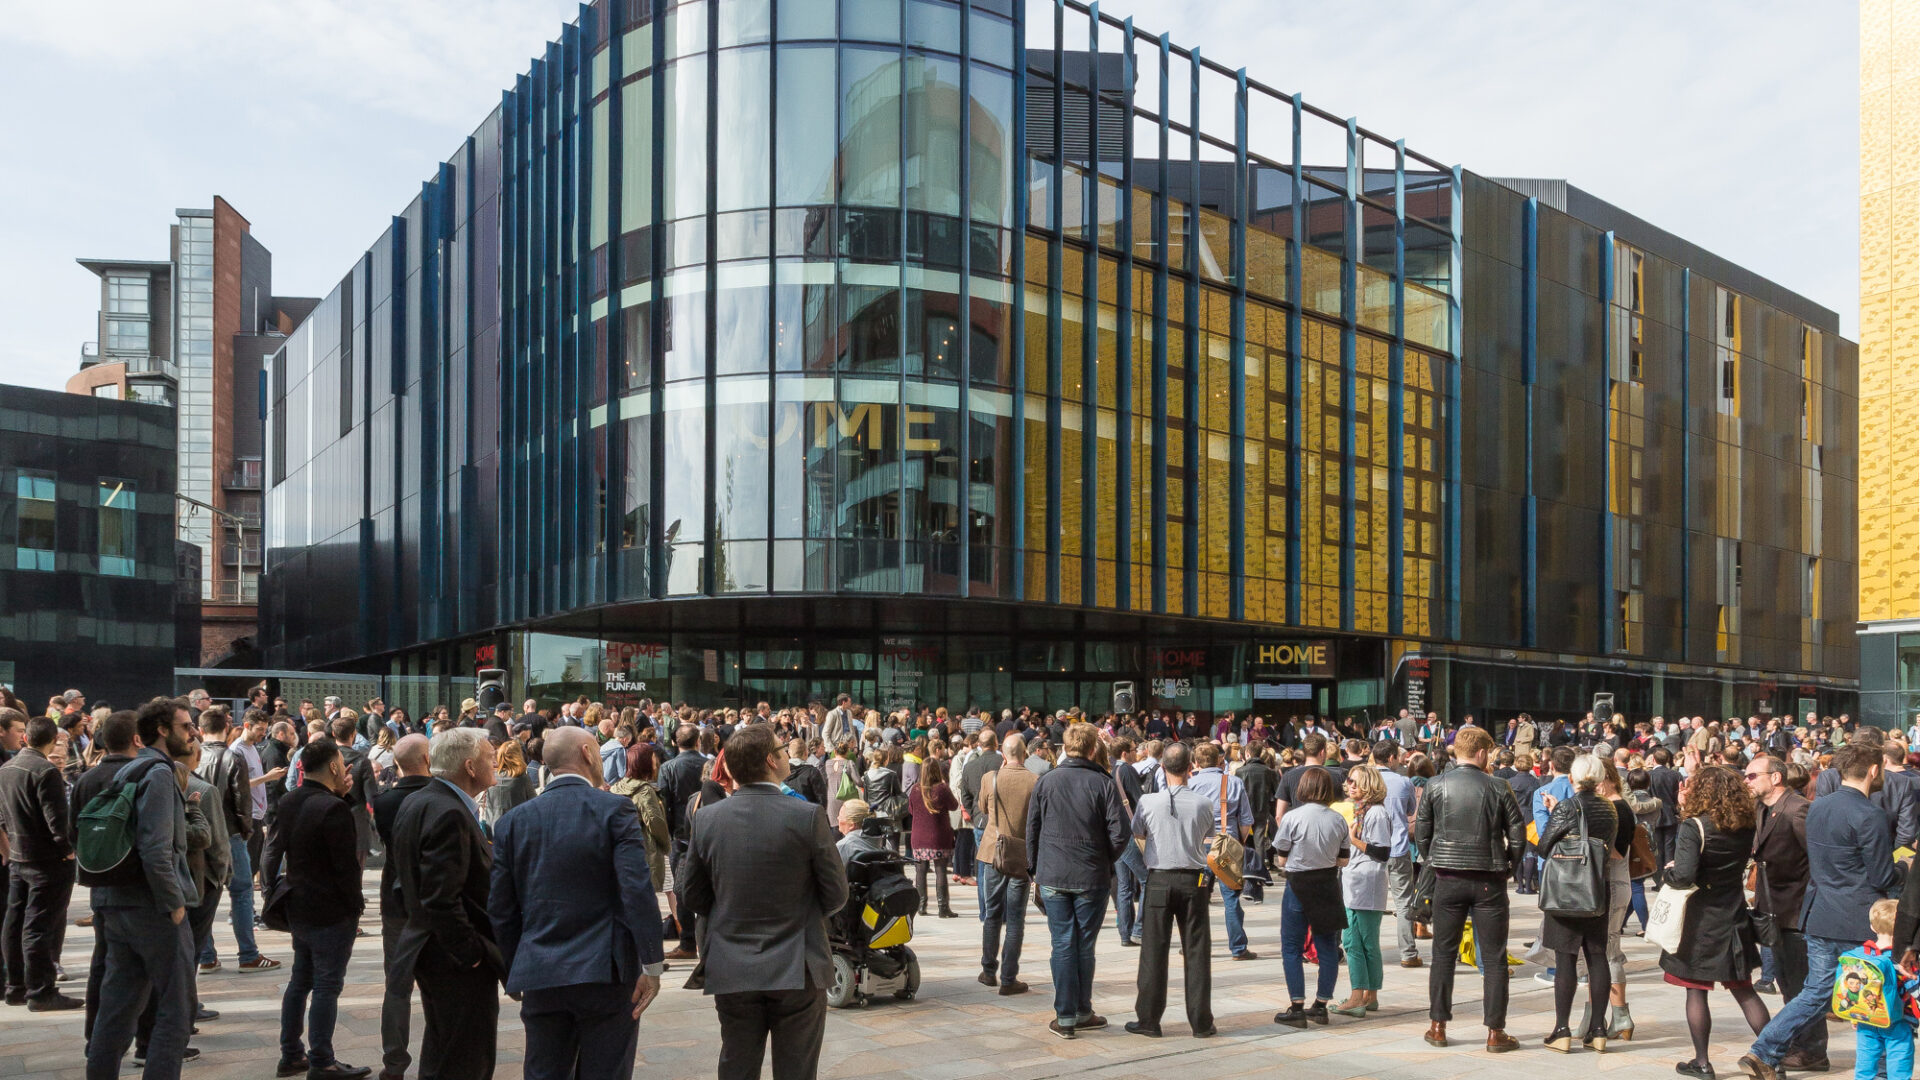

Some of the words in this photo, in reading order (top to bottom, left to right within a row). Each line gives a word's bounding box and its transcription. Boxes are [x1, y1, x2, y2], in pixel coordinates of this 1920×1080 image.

[743, 401, 941, 451] OME
[476, 645, 495, 661] HOME
[607, 643, 662, 658] HOME
[883, 647, 938, 662] HOME
[1152, 649, 1206, 666] HOME
[1259, 645, 1327, 664] HOME
[606, 672, 625, 682] THE
[606, 682, 646, 691] FUNFAIR
[1152, 687, 1192, 696] MOKEY
[889, 697, 916, 707] gallery
